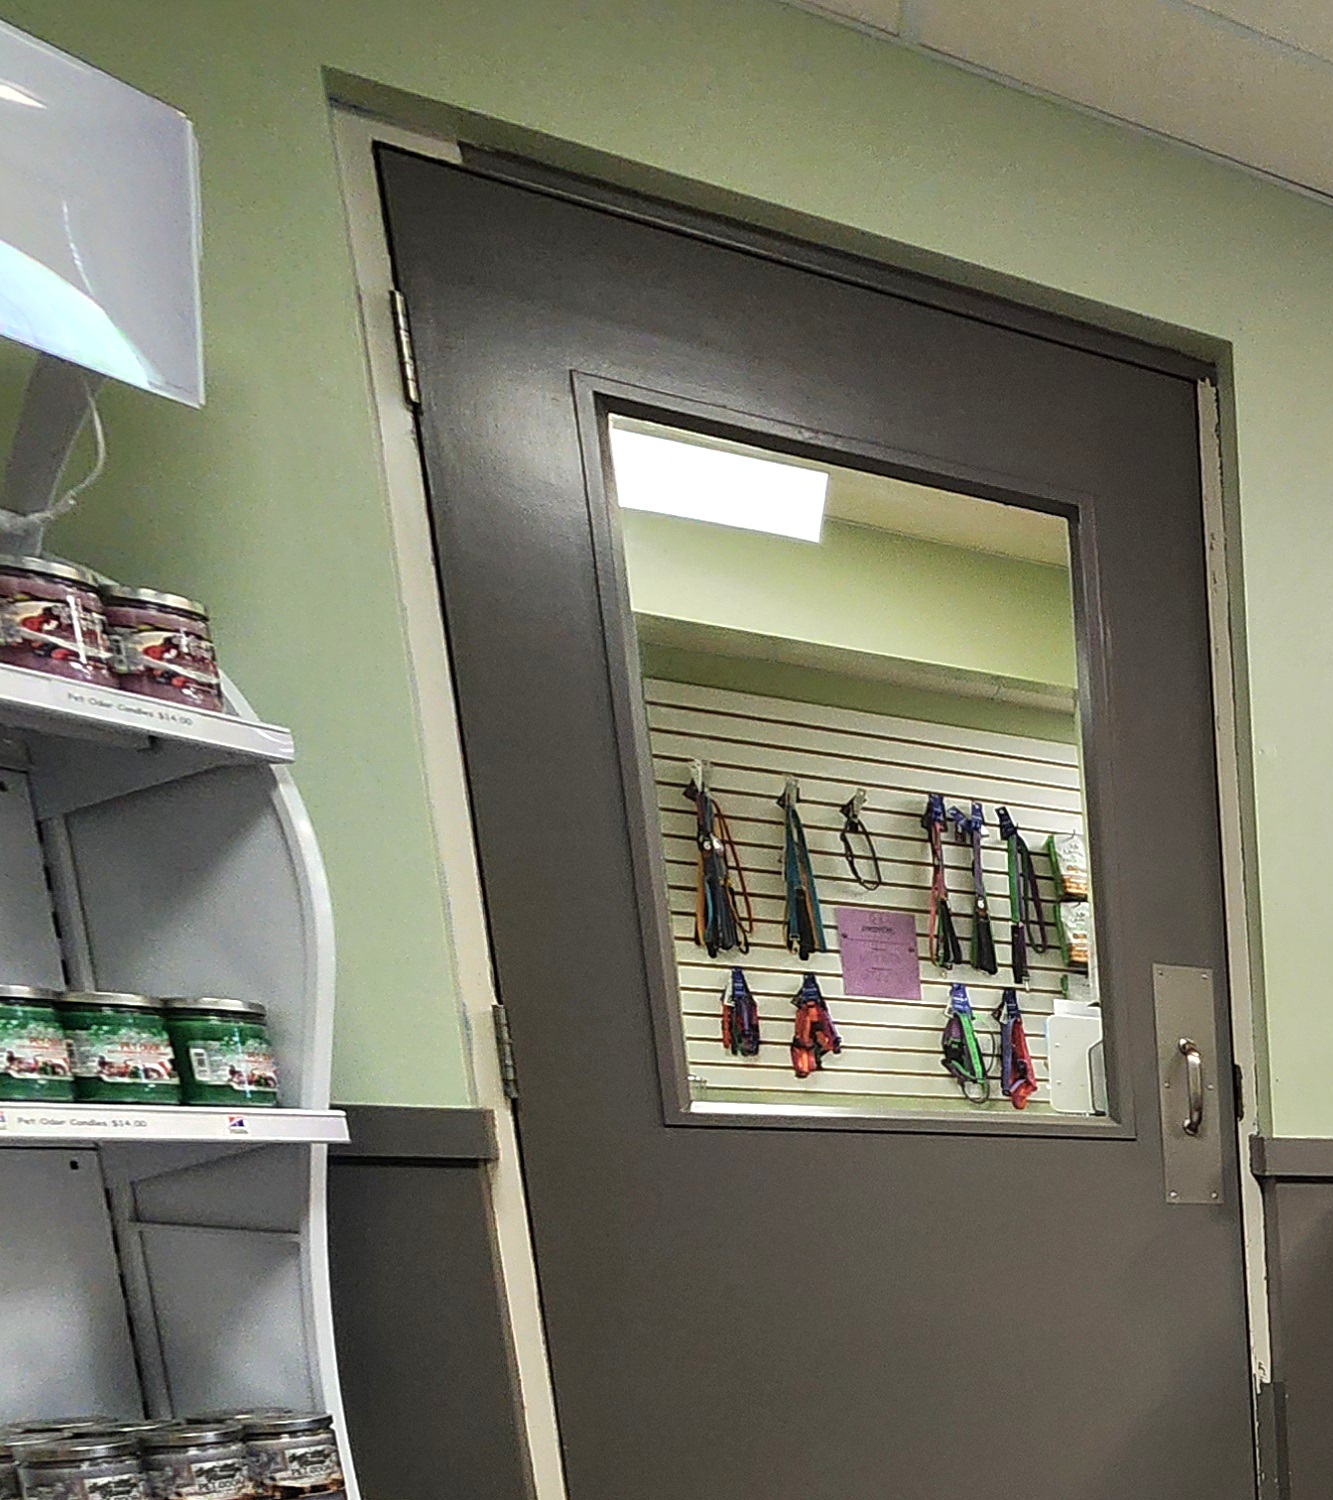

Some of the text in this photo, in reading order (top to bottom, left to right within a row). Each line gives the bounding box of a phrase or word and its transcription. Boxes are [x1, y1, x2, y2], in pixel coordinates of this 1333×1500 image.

[17, 1116, 148, 1128] Pet Odor Candles $14.00
